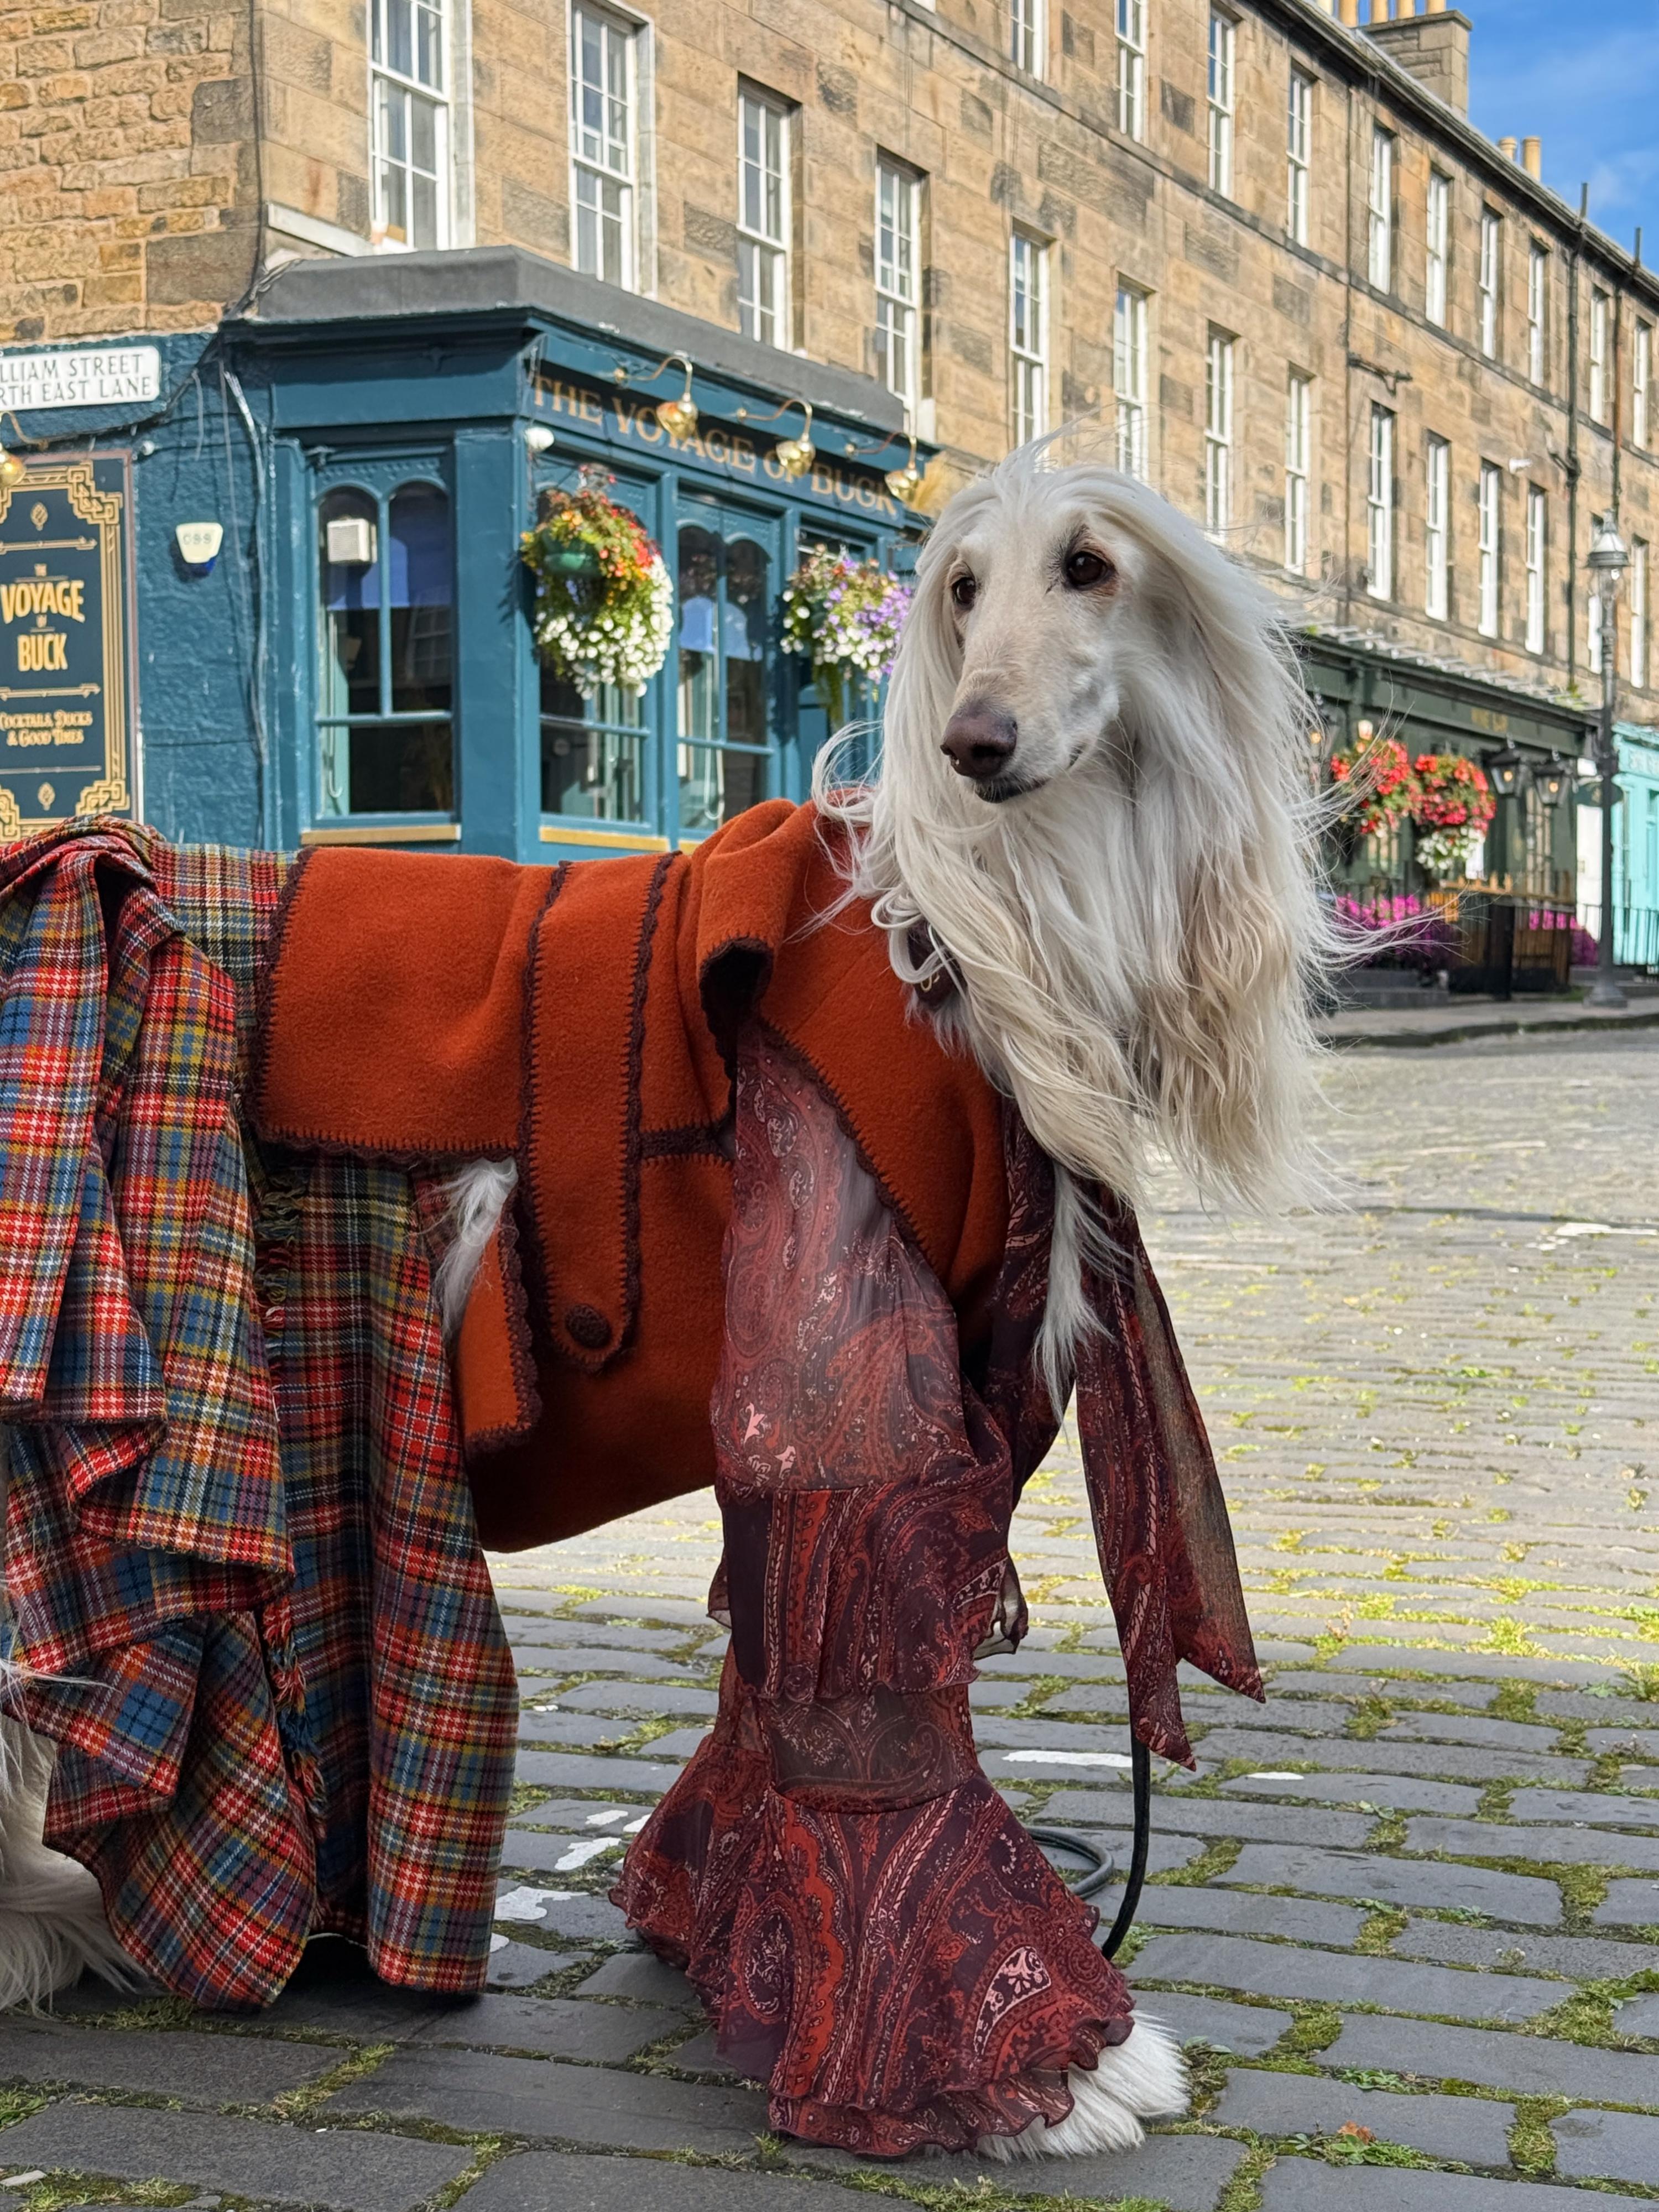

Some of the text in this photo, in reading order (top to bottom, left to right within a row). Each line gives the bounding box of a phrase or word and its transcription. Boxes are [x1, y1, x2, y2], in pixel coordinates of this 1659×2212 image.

[69, 354, 143, 377] STREET
[42, 379, 88, 402] EAST
[100, 377, 151, 398] LANE
[534, 375, 603, 426] THE
[0, 580, 86, 624] VOYAGE
[17, 633, 68, 671] BUCK
